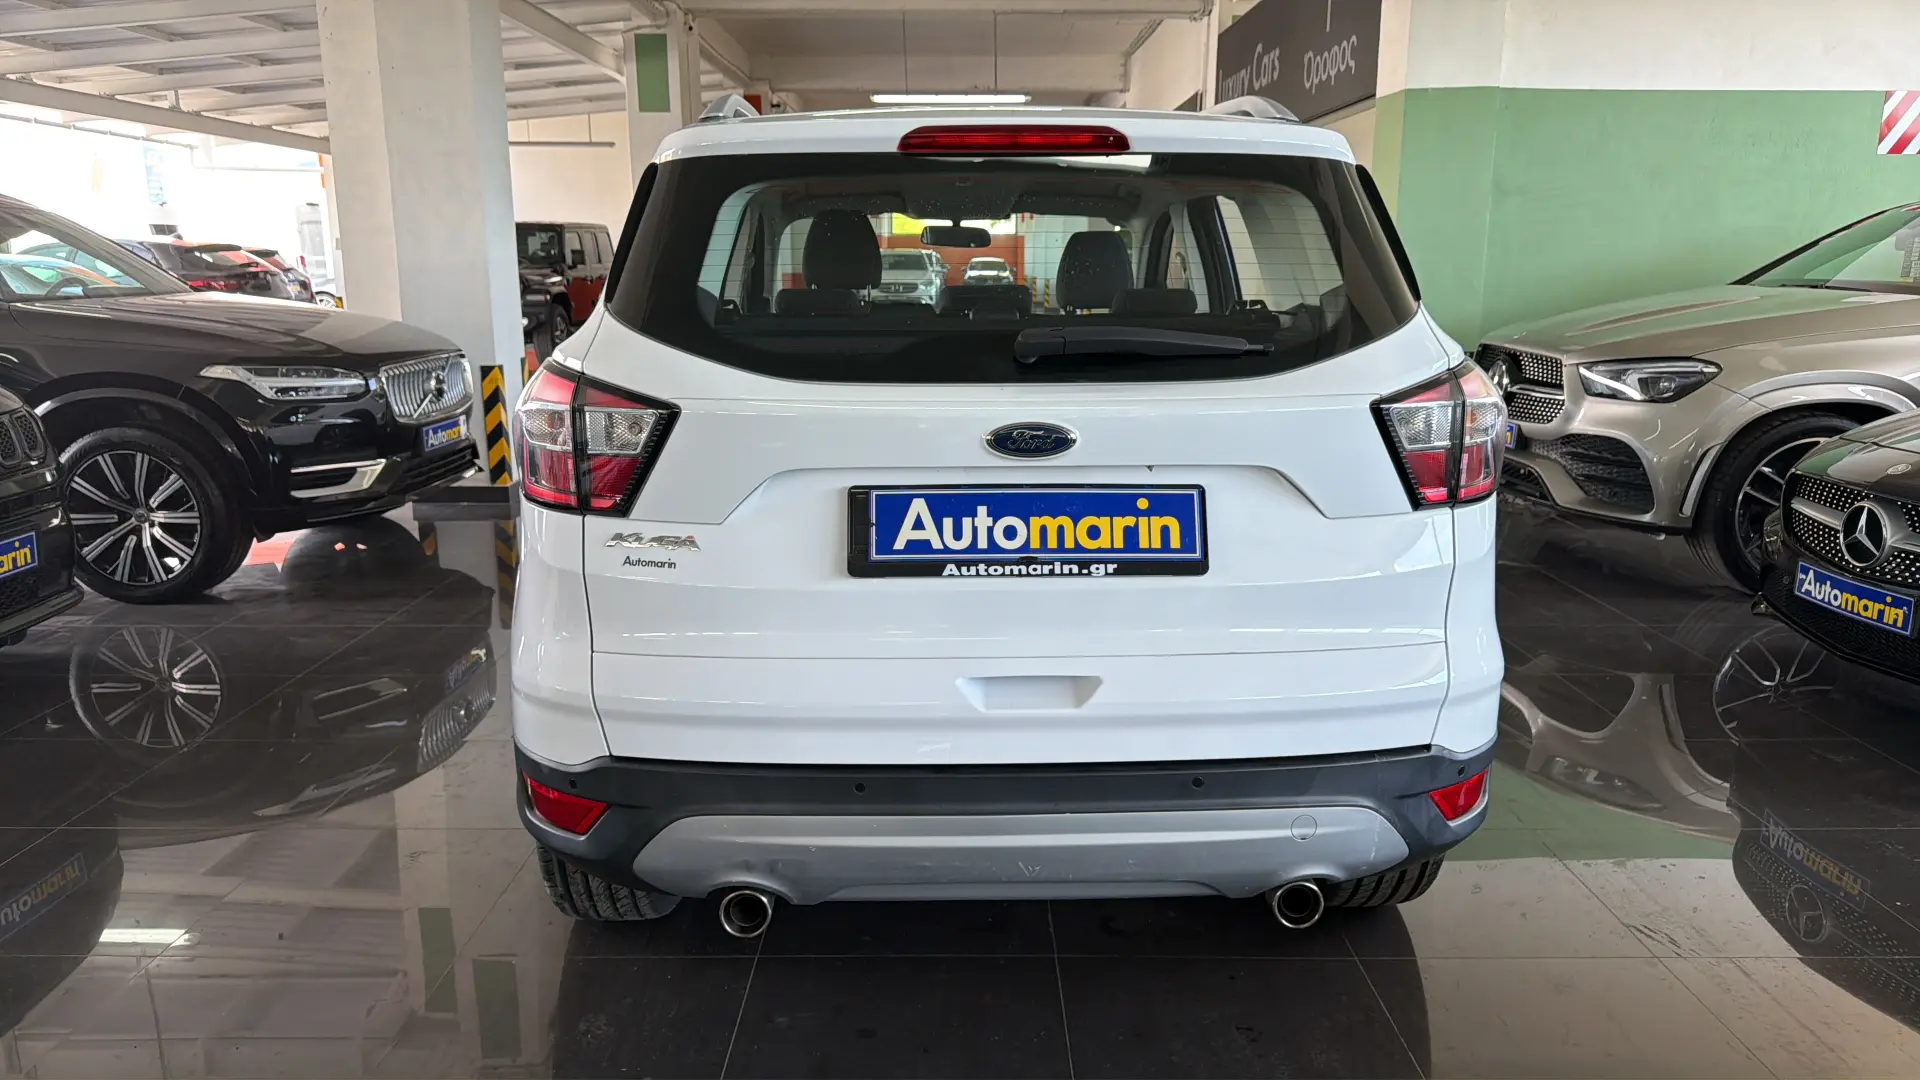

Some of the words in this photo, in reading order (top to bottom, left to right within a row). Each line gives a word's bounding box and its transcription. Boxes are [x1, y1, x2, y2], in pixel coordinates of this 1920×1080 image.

[1218, 65, 1251, 102] Luxury
[1252, 43, 1280, 91] Cars
[1007, 429, 1066, 449] Ford
[892, 497, 1181, 550] Automarin
[604, 532, 702, 552] KUGA
[622, 555, 677, 569] Automarin
[941, 561, 1118, 577] Automarin.gr
[1801, 569, 1905, 628] Automarin
